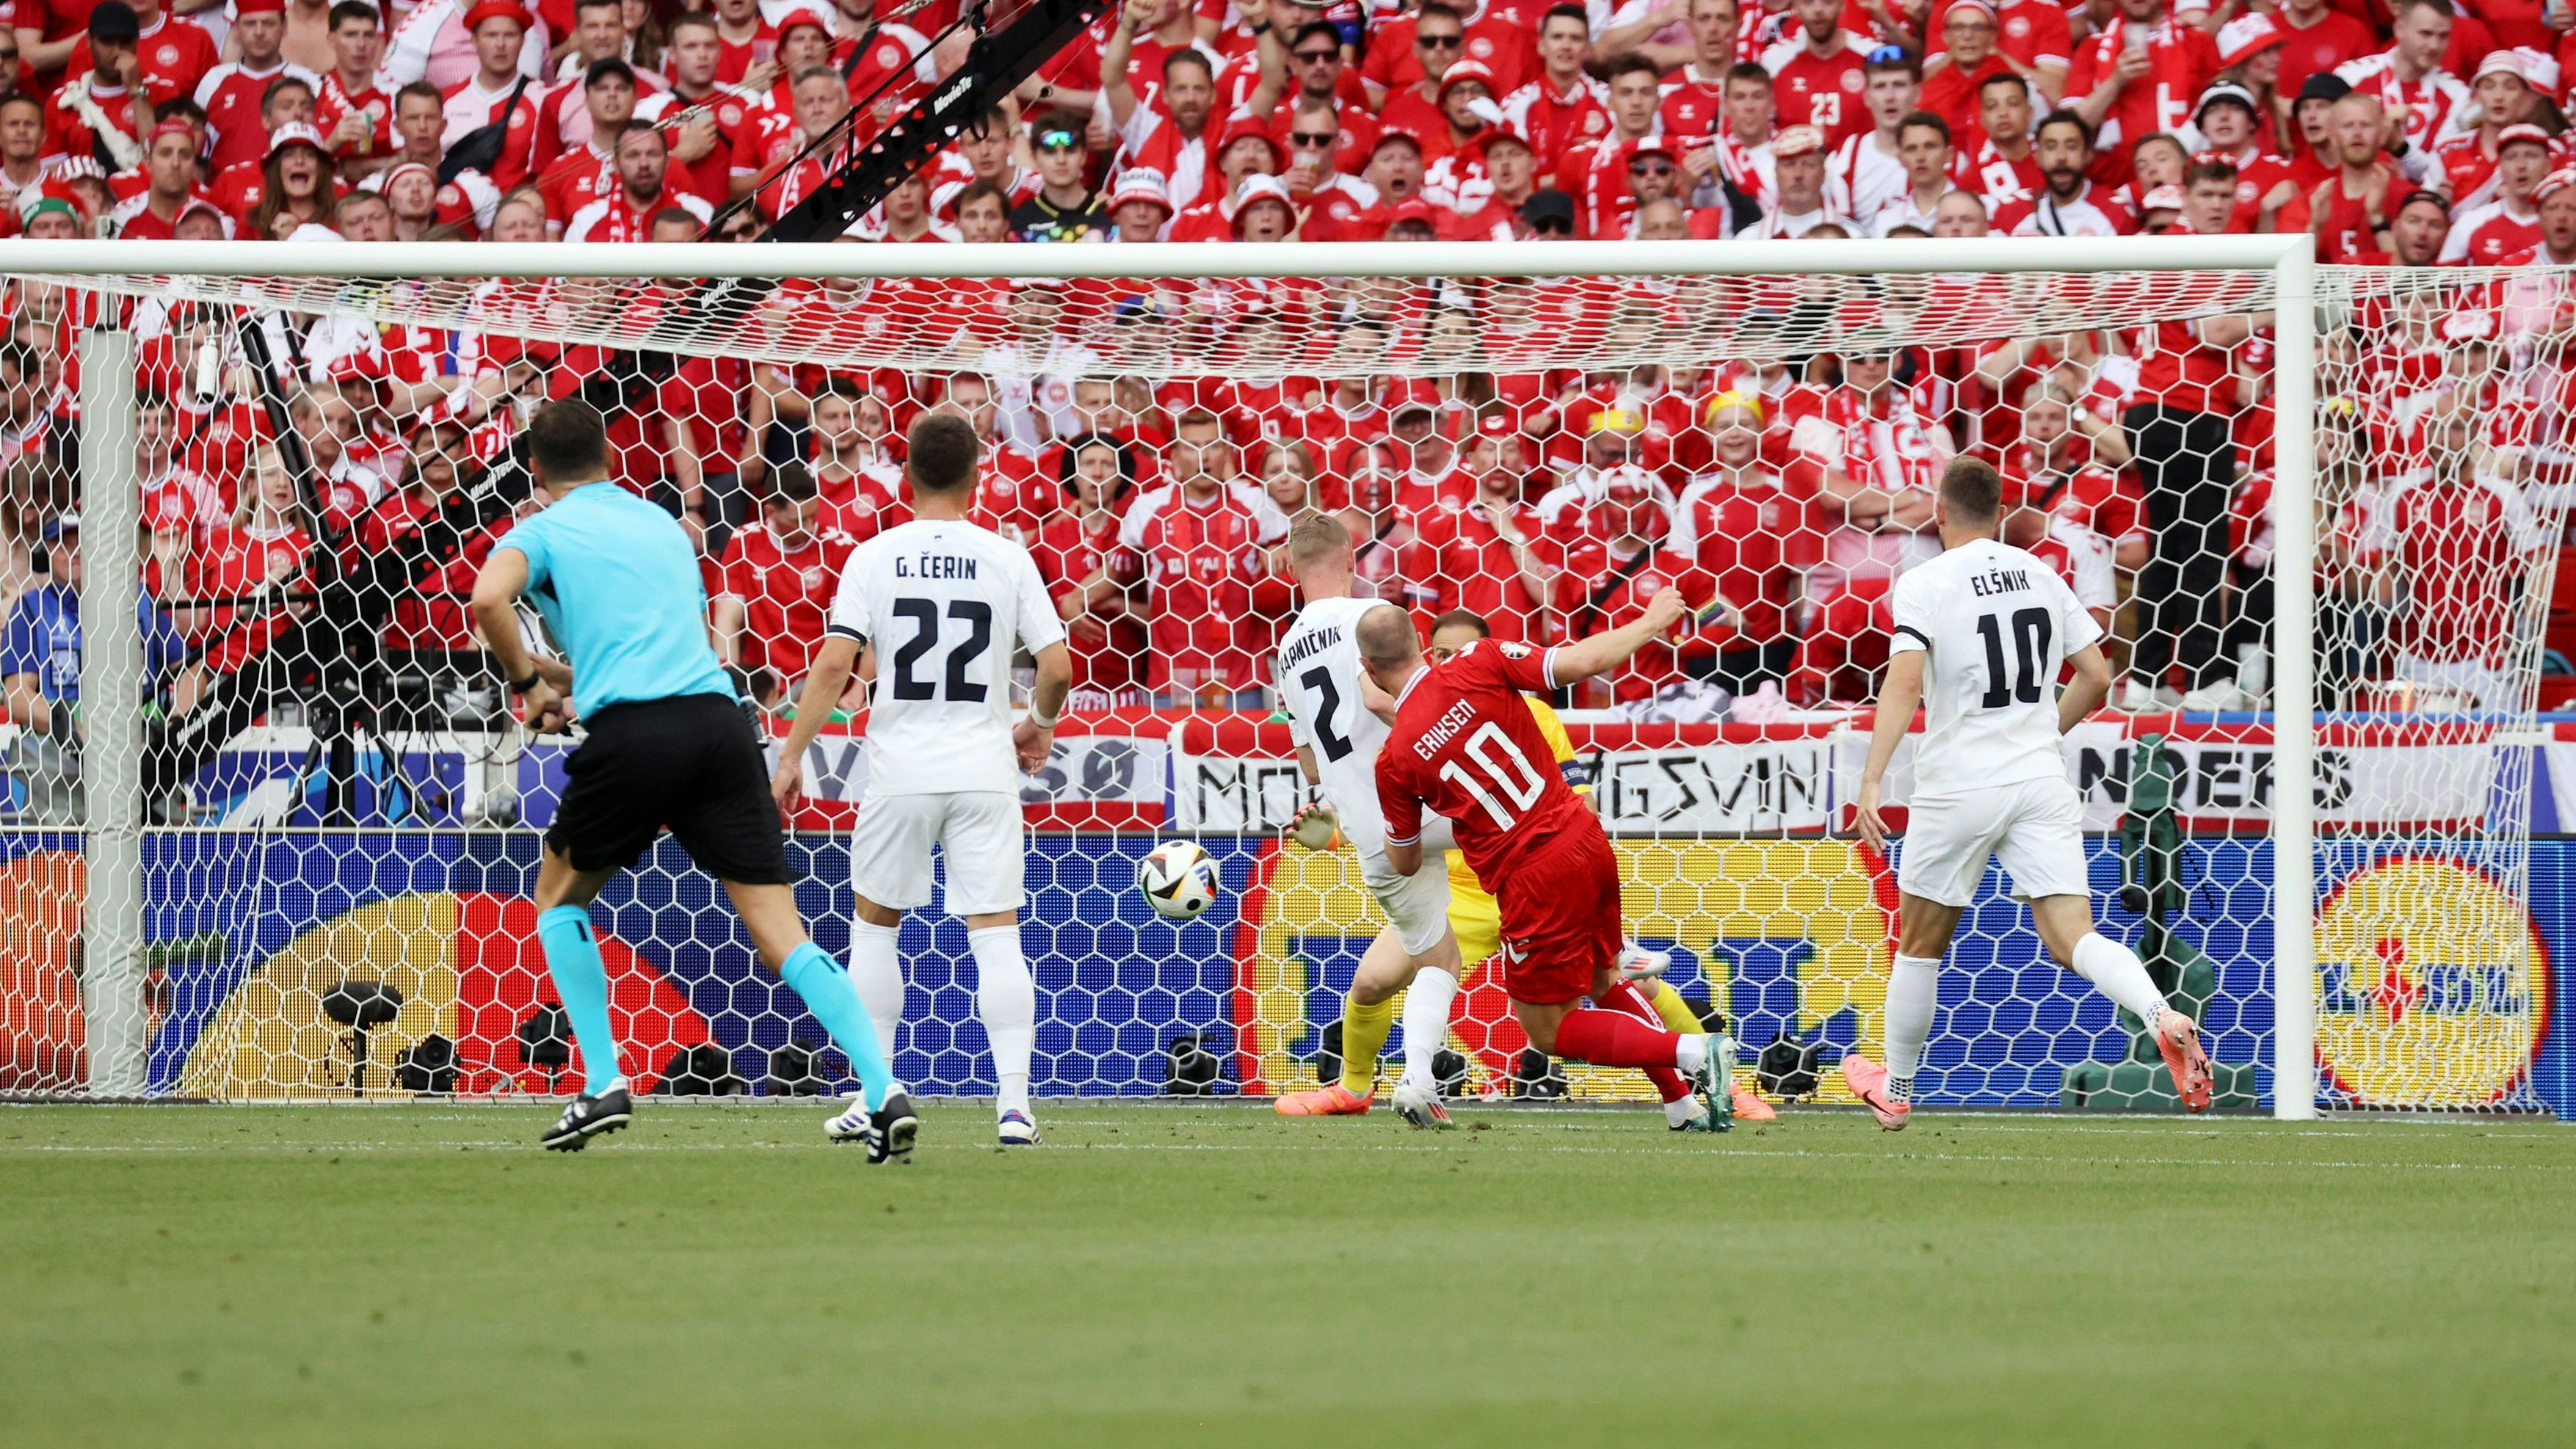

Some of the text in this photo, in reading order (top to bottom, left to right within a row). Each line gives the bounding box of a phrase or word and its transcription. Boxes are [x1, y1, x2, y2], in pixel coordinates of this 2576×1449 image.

[934, 75, 973, 115] MovieTe
[1810, 91, 1840, 126] 23
[2340, 229, 2358, 257] 5
[896, 551, 976, 580] G. ČERIN
[1970, 568, 2031, 597] ELŠNIK
[893, 598, 992, 702] 22
[1976, 607, 2052, 708] 10
[1300, 665, 1354, 763] 2
[1412, 697, 1477, 761] ERIKSEN
[1439, 720, 1546, 832] 10
